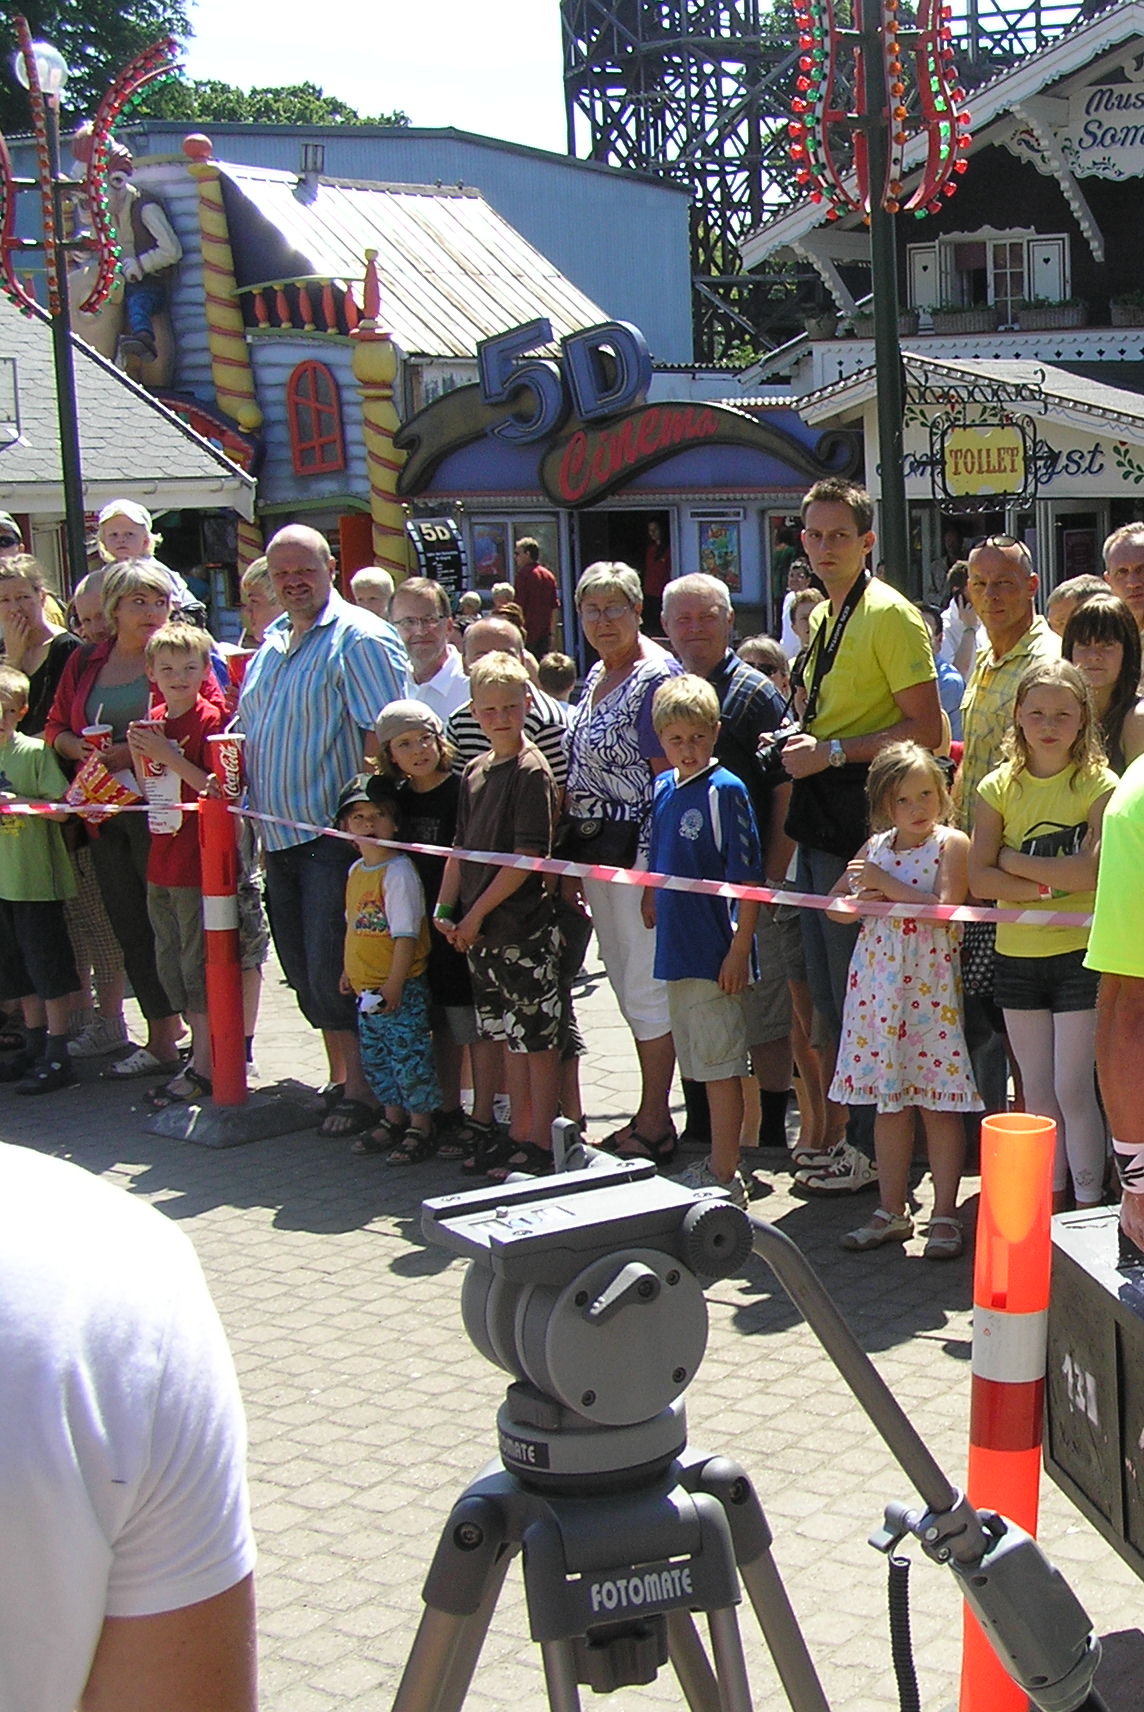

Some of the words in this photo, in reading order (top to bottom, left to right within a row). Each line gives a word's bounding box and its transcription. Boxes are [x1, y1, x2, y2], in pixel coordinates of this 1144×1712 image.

[476, 318, 653, 444] 5D
[559, 406, 720, 501] Cinema
[950, 446, 1020, 476] TOILET
[420, 523, 451, 541] 5D
[590, 1567, 693, 1611] FOTOMATE
